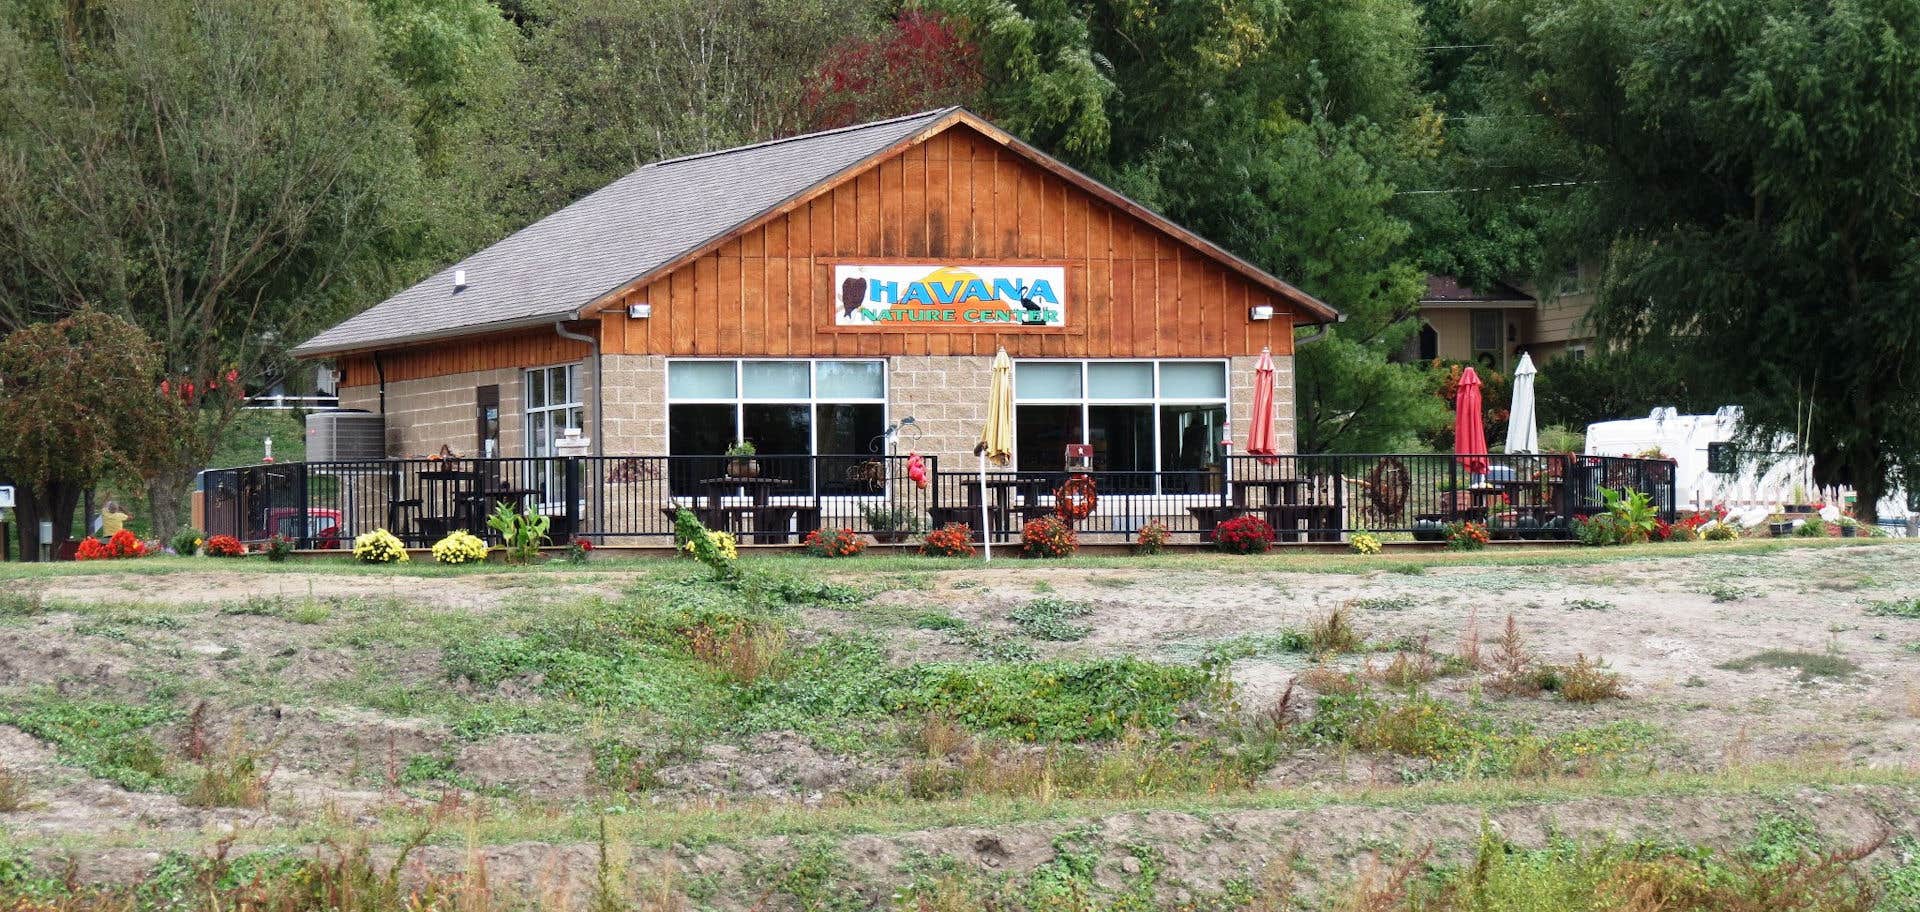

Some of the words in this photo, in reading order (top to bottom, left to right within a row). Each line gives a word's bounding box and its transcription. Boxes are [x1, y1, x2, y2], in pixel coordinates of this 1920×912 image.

[869, 278, 1059, 304] HAVANA
[860, 308, 956, 321] NATURE
[963, 308, 1058, 322] CENTER
